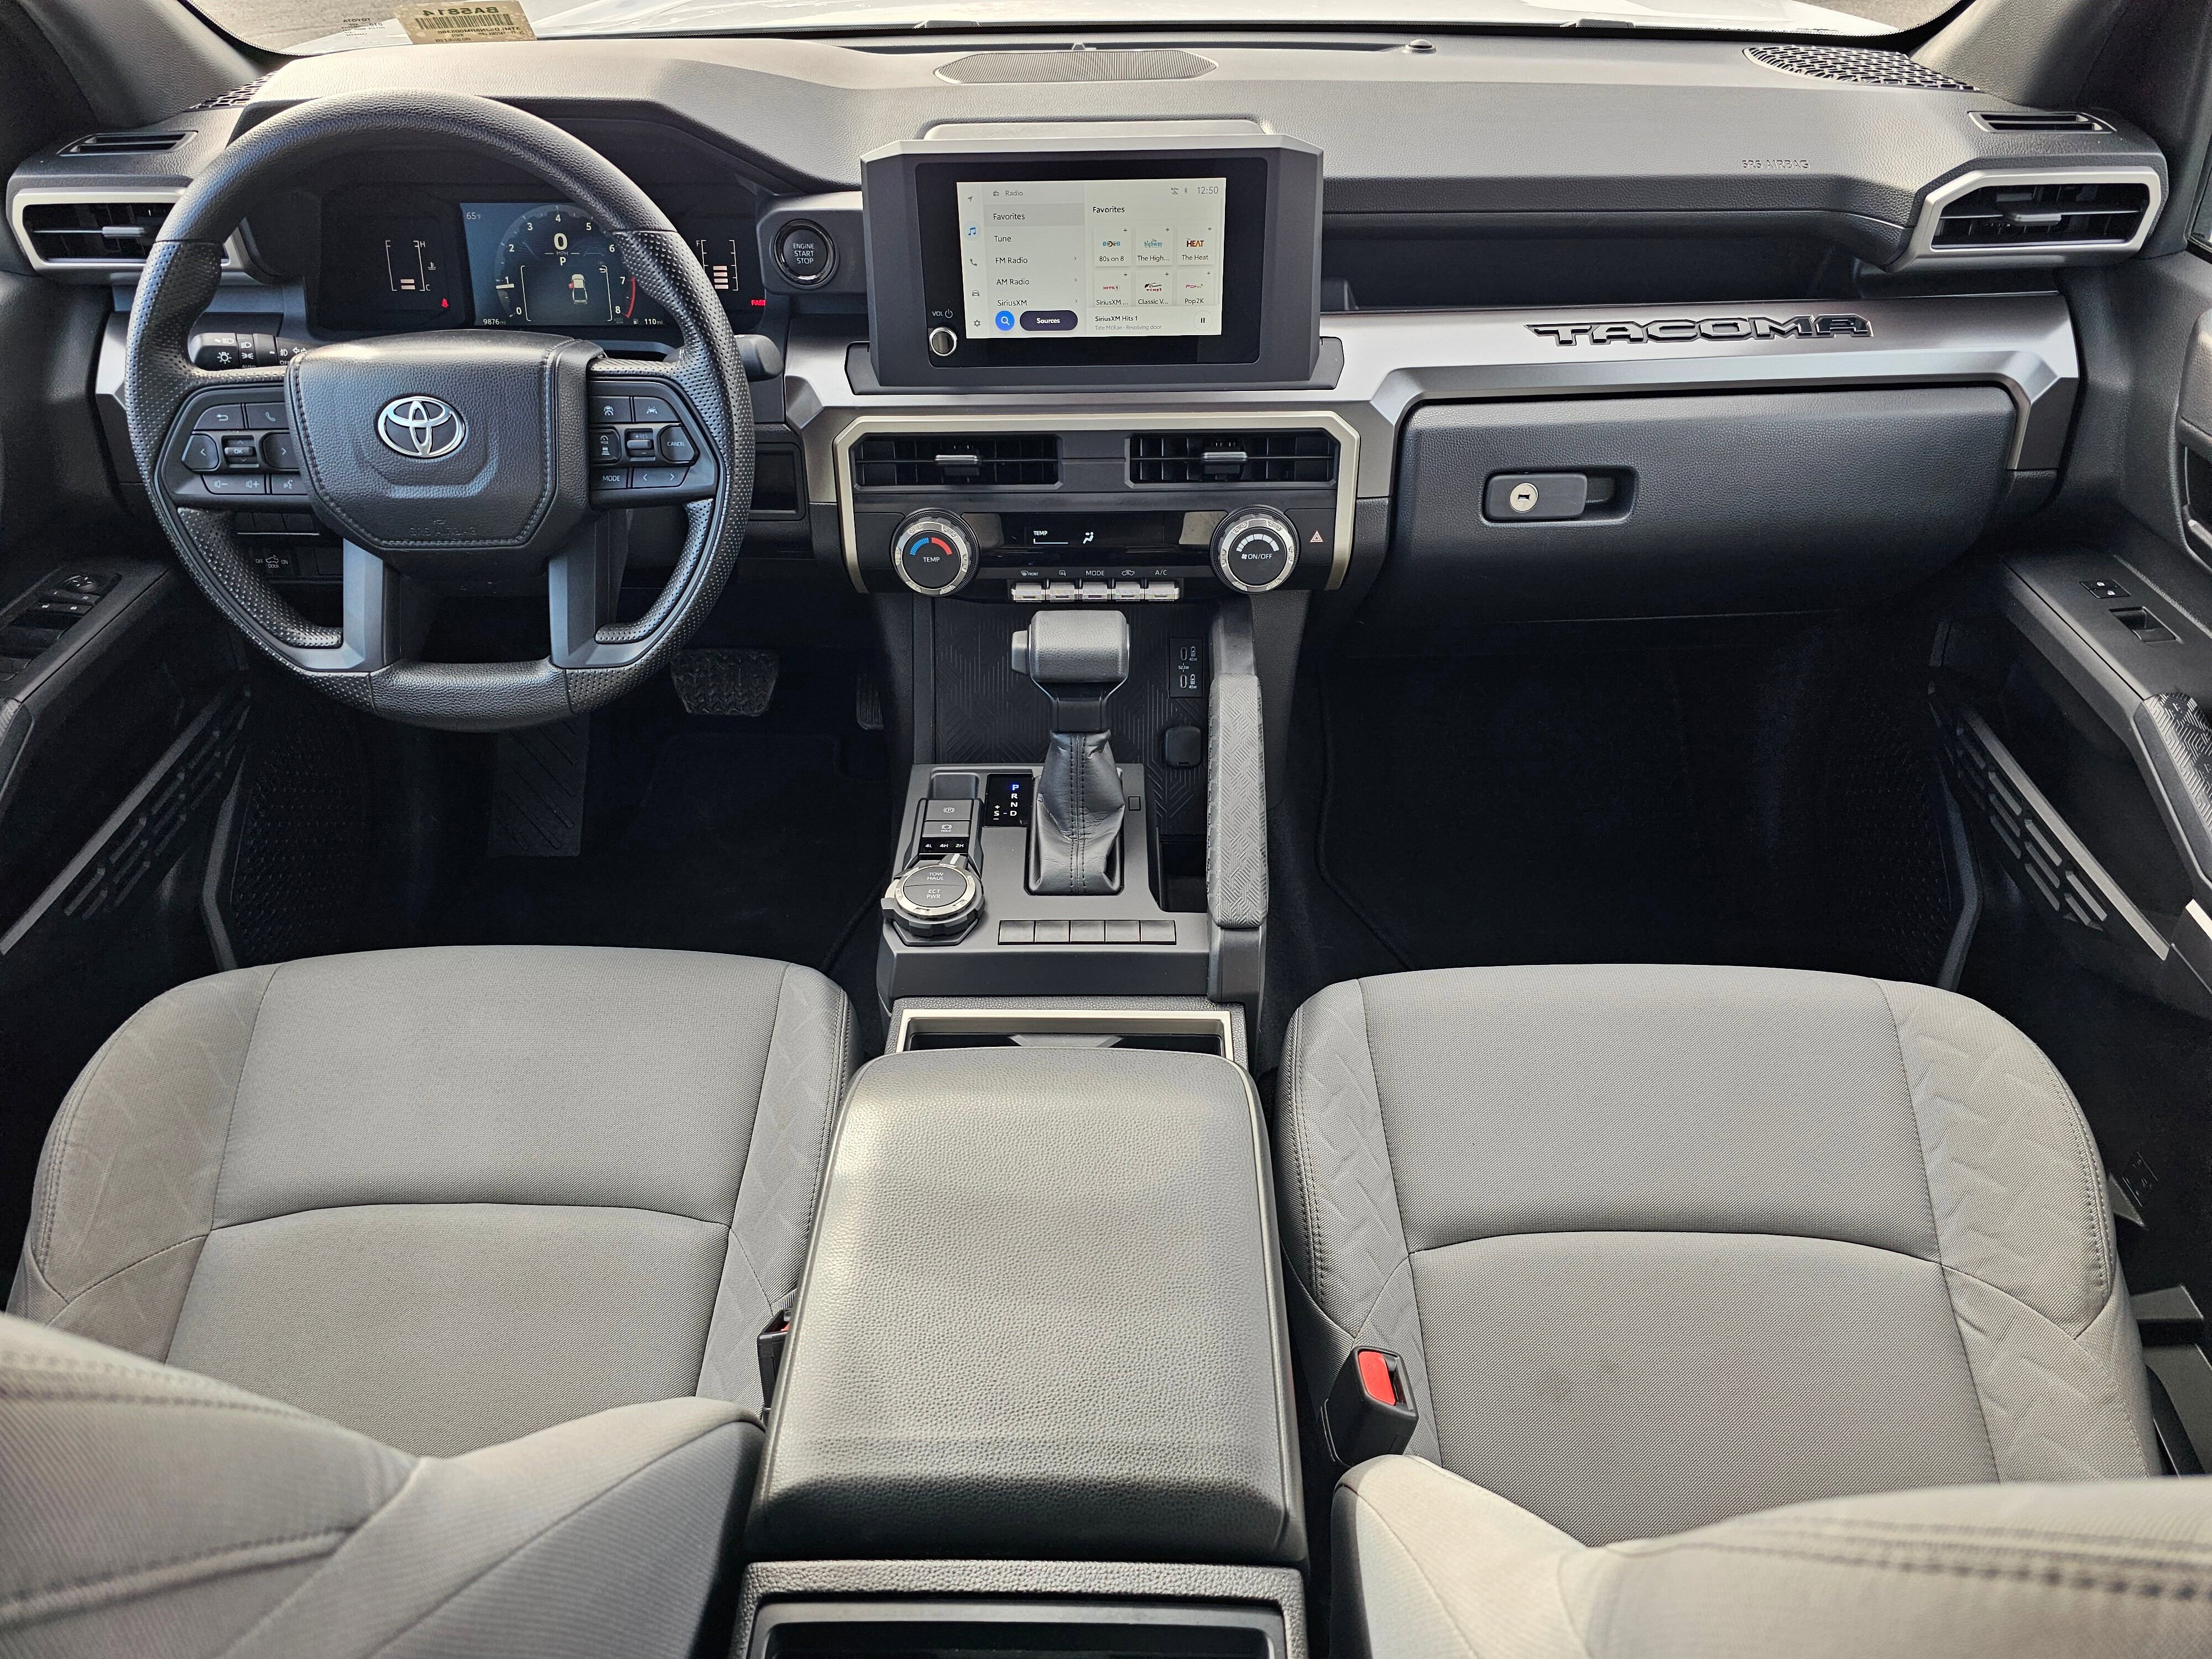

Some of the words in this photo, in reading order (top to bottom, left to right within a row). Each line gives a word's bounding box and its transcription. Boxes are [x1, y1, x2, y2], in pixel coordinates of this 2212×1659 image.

[1742, 160, 1762, 168] SRS
[1766, 159, 1811, 169] AIRBAG
[555, 214, 561, 222] 4
[527, 222, 533, 231] 3
[586, 222, 592, 231] 5
[554, 233, 568, 251] 0
[508, 244, 515, 252] 2
[609, 244, 615, 253] 6
[560, 257, 566, 266] P
[620, 276, 625, 285] 7
[516, 307, 522, 315] 0
[615, 306, 621, 314] 8
[1524, 314, 1874, 346] TACOMA
